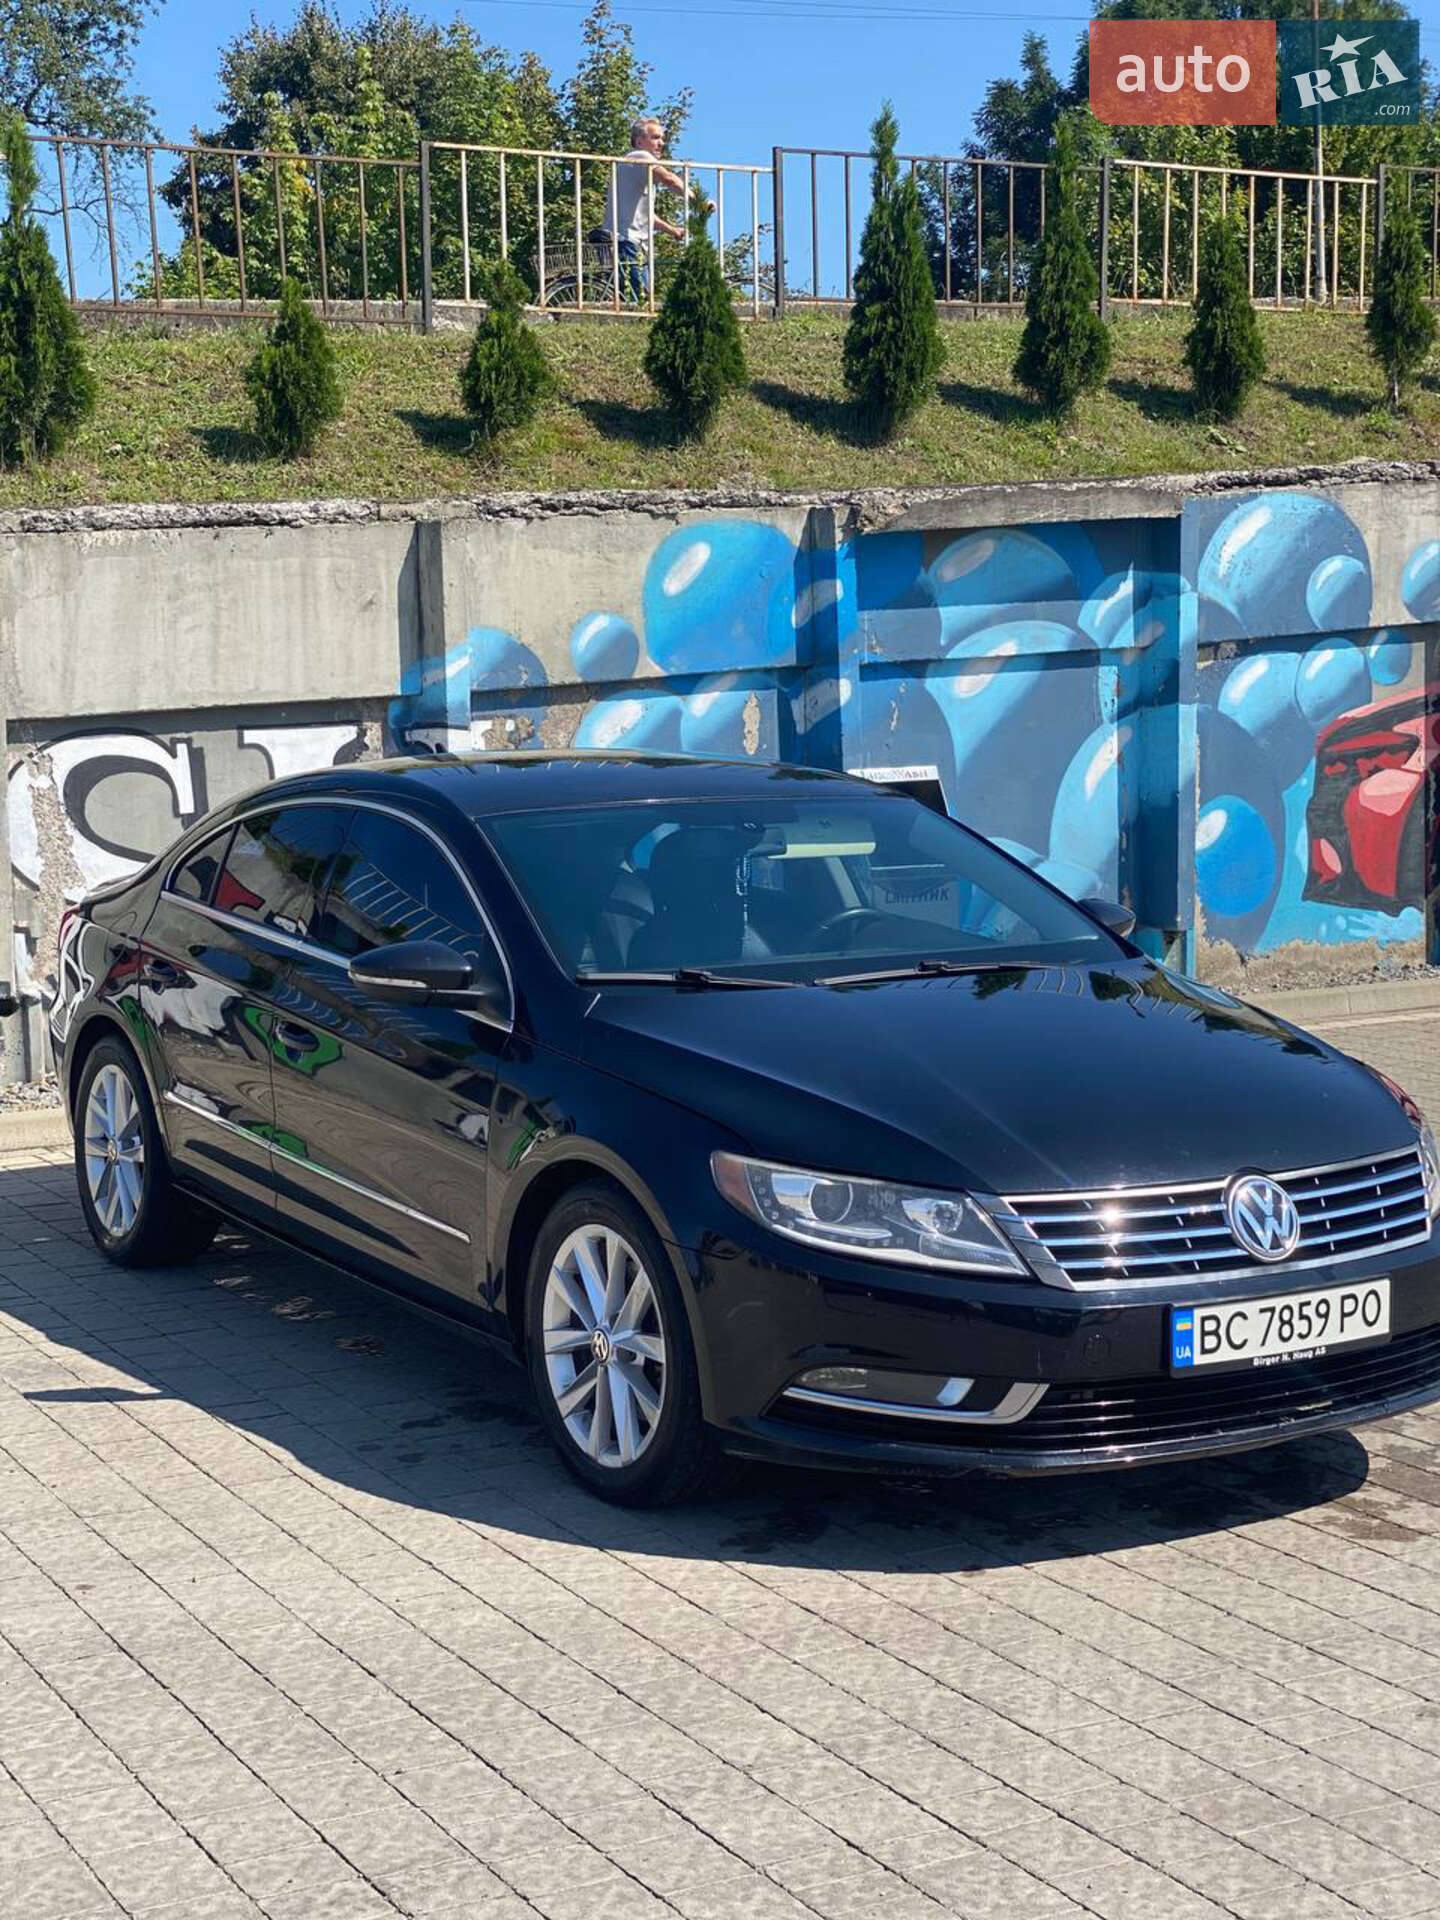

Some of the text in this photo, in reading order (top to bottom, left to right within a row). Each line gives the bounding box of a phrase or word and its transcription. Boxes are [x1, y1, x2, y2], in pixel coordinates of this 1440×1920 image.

[1200, 1289, 1381, 1355] BC 7859 PO
[1176, 1345, 1192, 1359] UA
[1253, 1355, 1280, 1366] Birger
